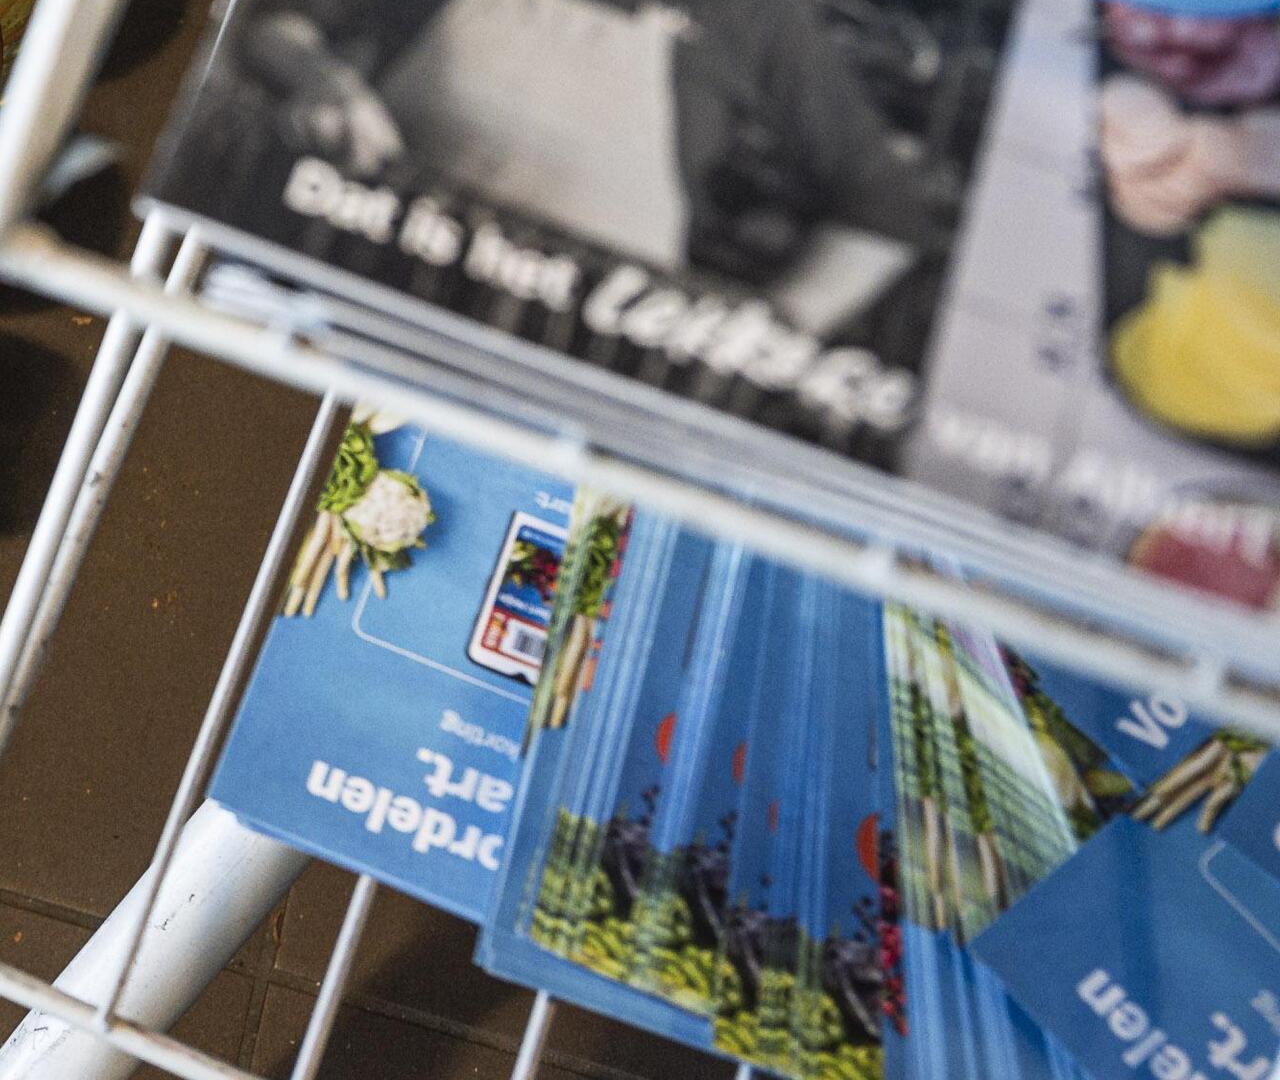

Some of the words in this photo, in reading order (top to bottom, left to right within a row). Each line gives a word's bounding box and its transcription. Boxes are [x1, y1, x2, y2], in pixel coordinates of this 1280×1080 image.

[283, 156, 400, 244] Dat
[399, 195, 463, 267] is
[463, 218, 580, 313] het
[306, 759, 505, 870] ordelen
[415, 744, 515, 813] art.
